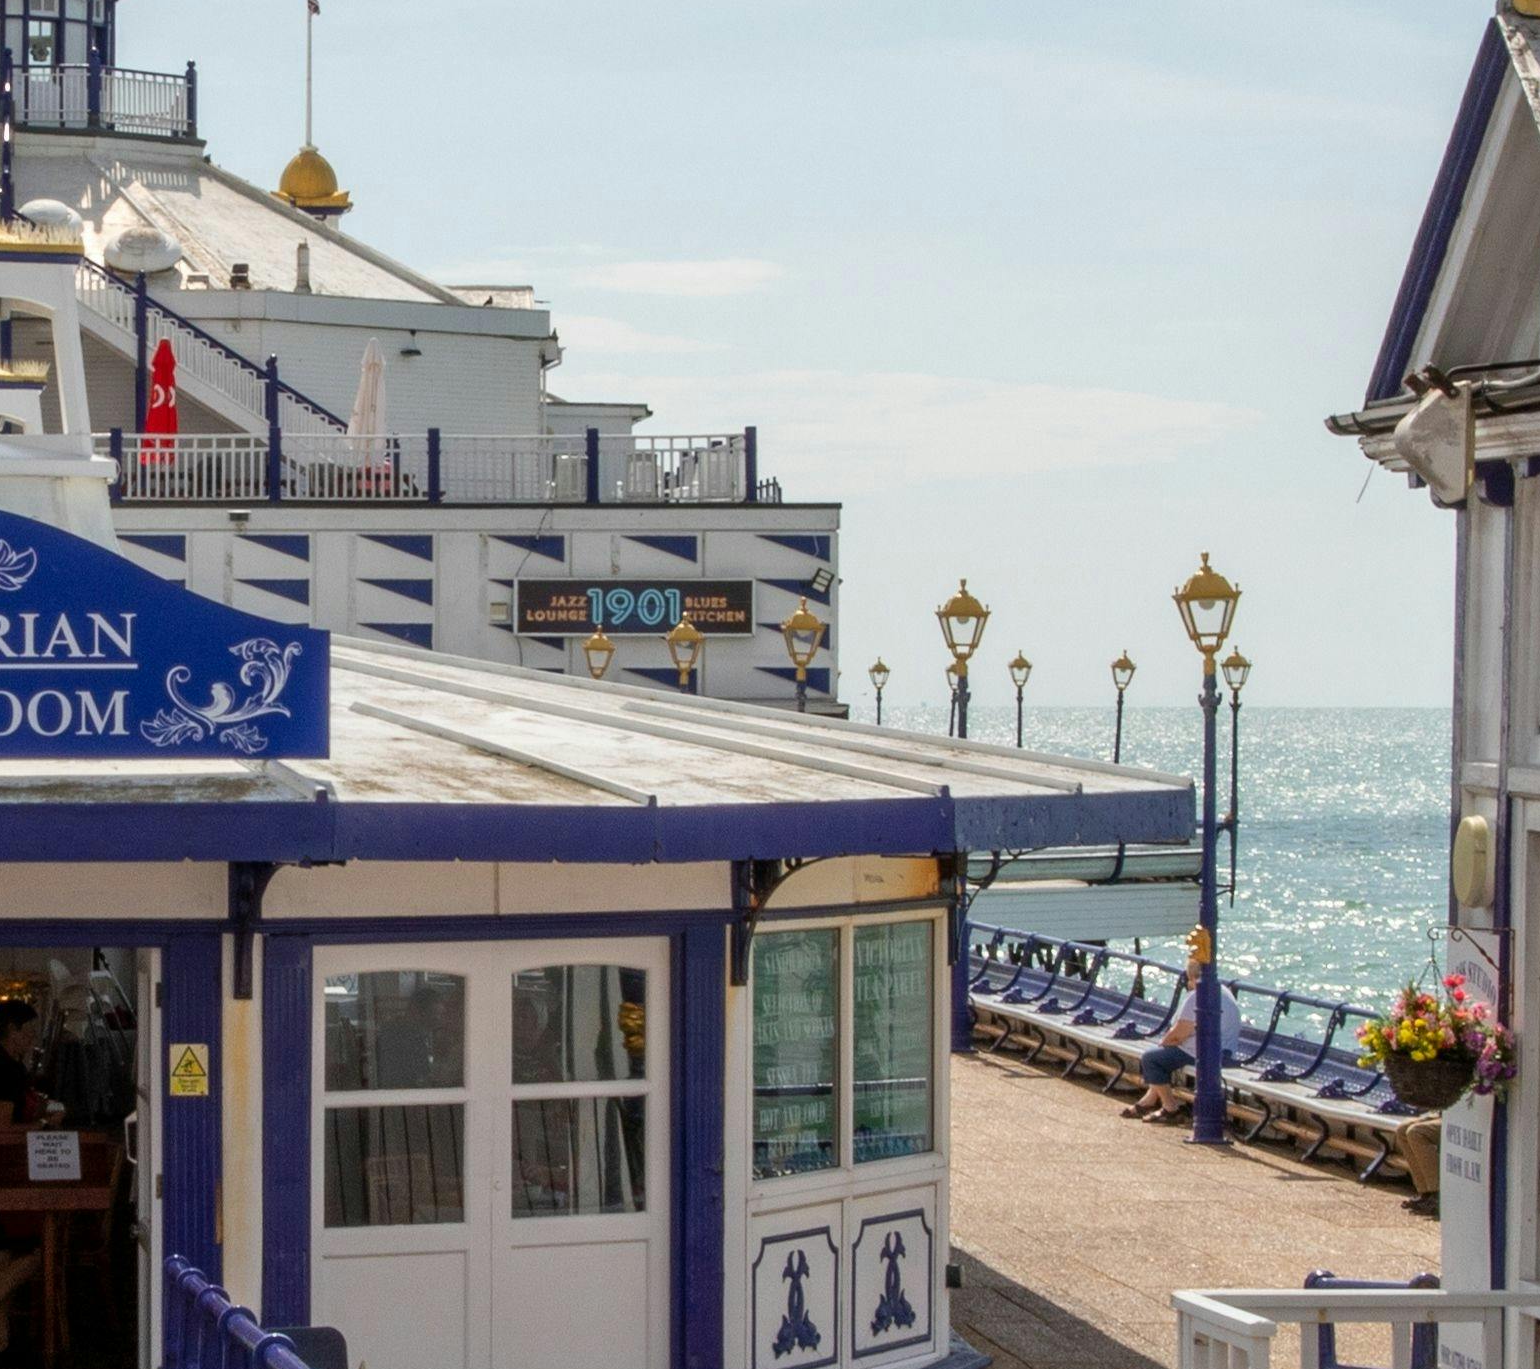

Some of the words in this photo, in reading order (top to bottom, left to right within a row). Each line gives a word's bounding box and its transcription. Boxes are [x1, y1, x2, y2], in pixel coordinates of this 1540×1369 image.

[550, 596, 587, 608] JAZZ
[586, 588, 680, 625] 1901
[685, 597, 727, 609] BLUES
[527, 609, 587, 621] LOUNGE
